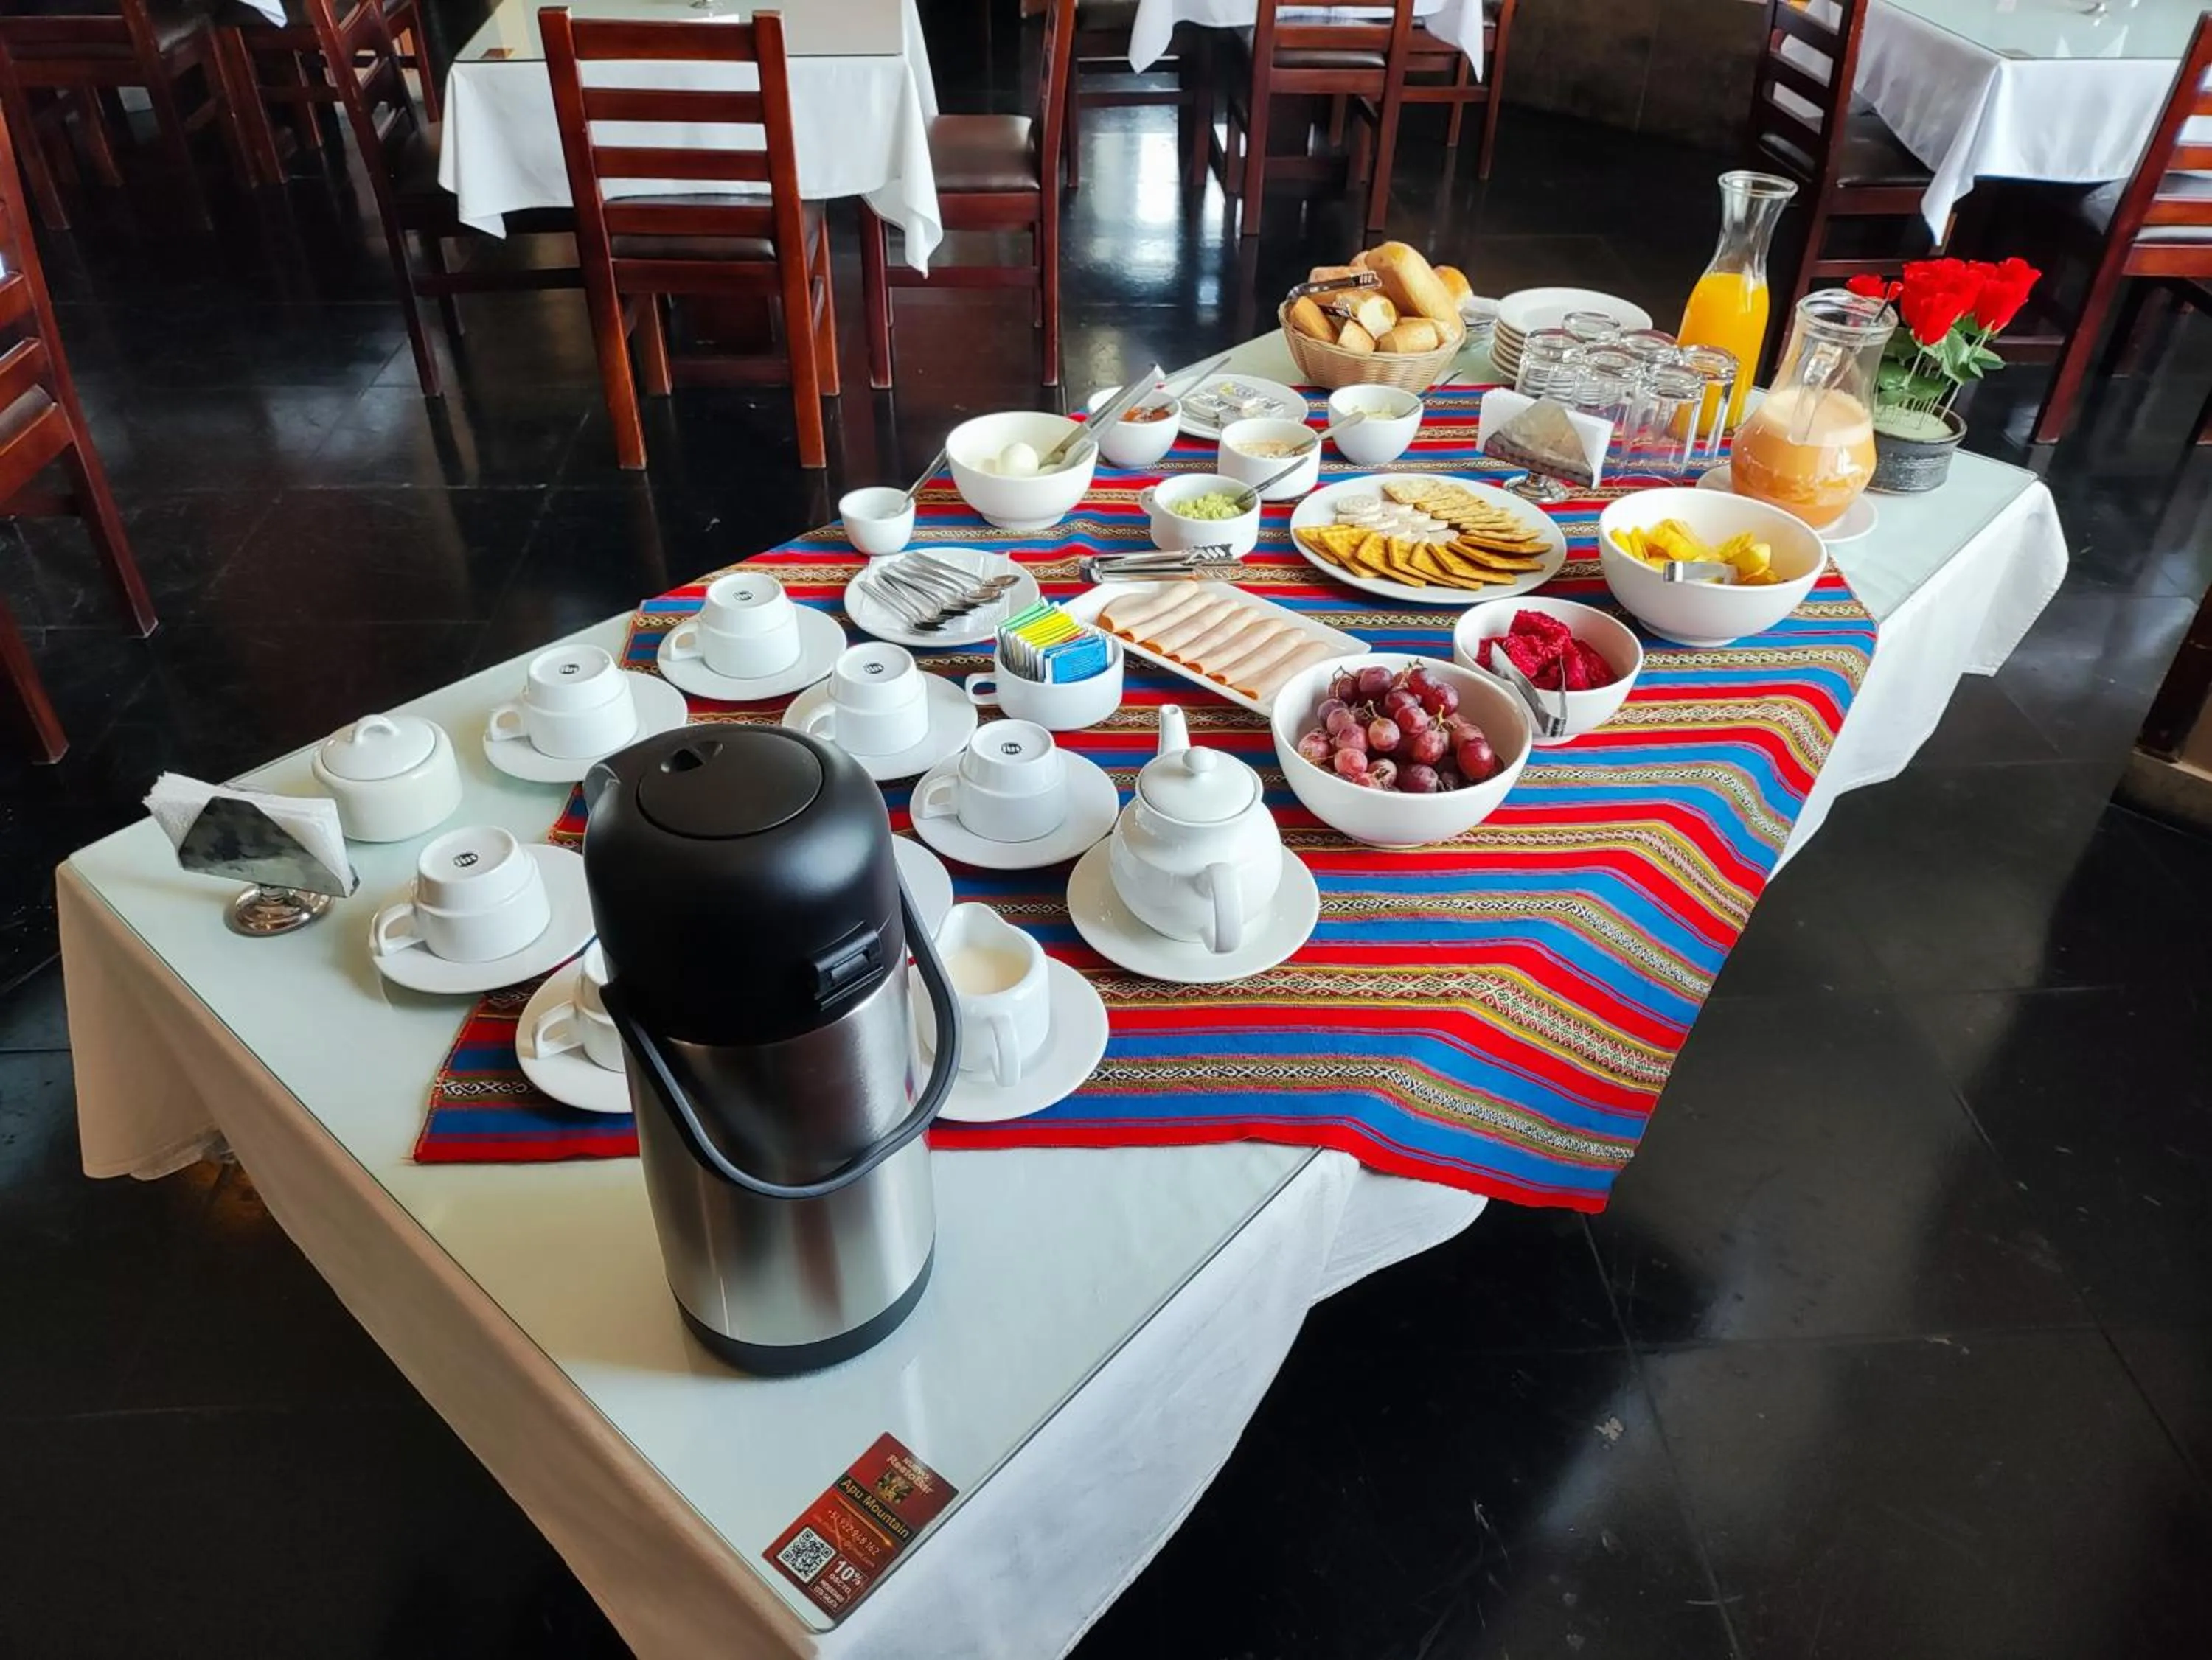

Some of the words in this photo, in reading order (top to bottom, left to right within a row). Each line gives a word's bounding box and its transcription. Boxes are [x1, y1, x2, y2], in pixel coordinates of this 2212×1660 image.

[841, 1479, 863, 1499] Apu
[863, 1495, 909, 1538] Mountain
[834, 1560, 863, 1586] 10%
